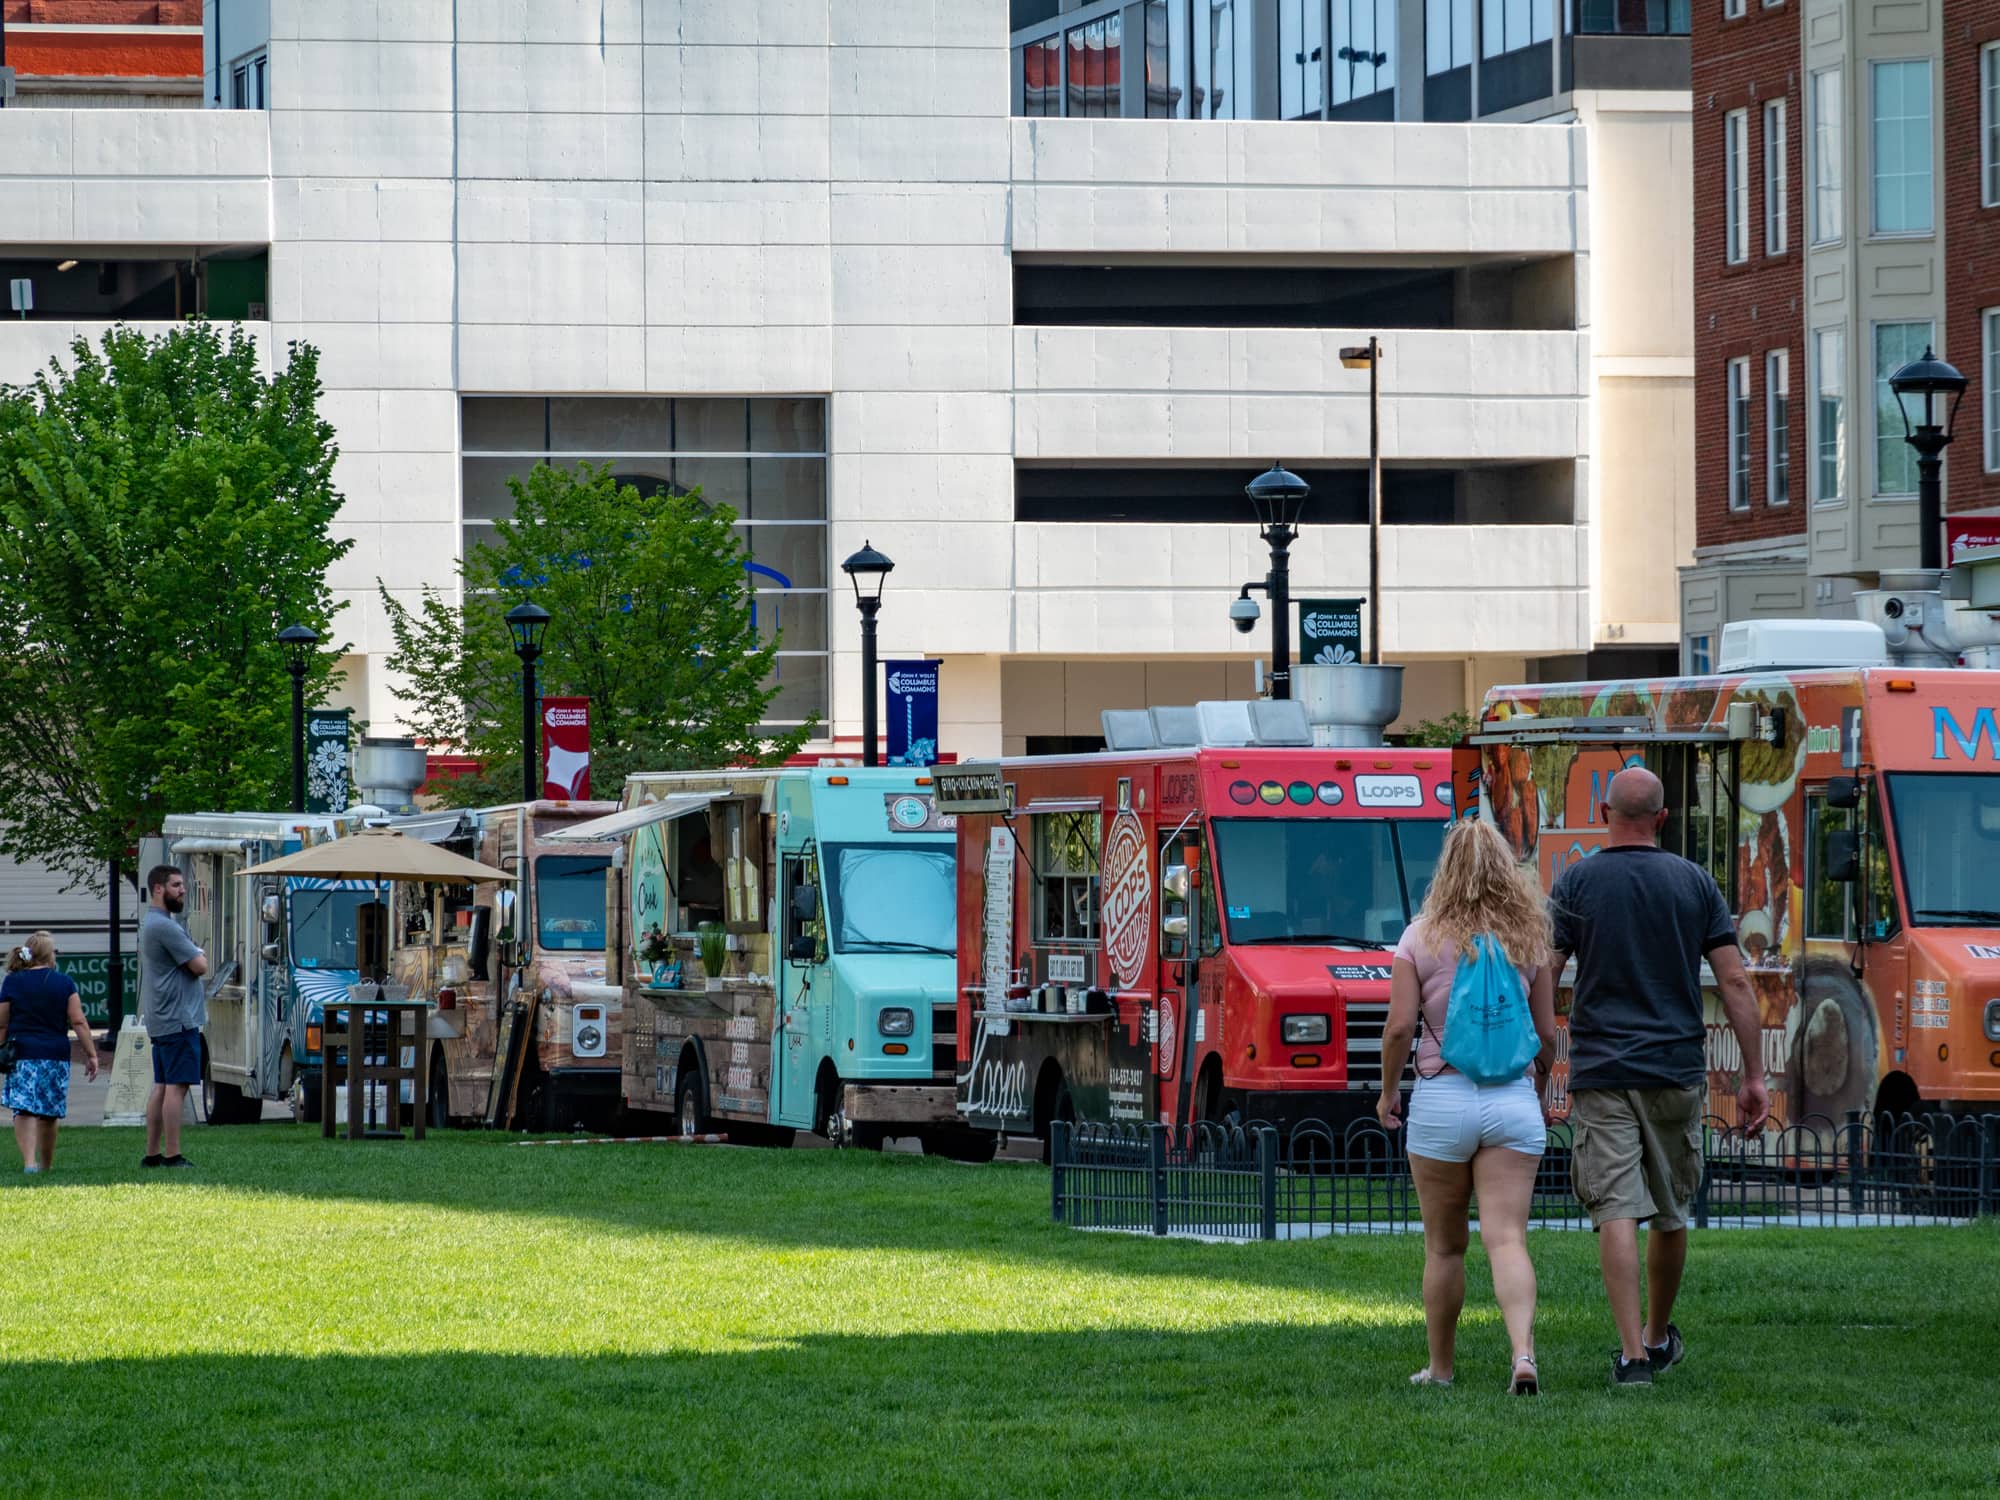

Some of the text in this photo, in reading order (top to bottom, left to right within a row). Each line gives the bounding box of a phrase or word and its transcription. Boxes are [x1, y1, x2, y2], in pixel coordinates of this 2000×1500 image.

[1317, 620, 1358, 629] COLUMBUS
[1317, 629, 1358, 637] COMMONS
[1161, 774, 1196, 804] LOOPS
[1361, 785, 1416, 798] LOOPS
[1113, 838, 1133, 882] GOOD
[1106, 857, 1147, 938] LOOPS
[1119, 911, 1141, 957] FOOD
[1705, 1027, 1740, 1073] FOOD
